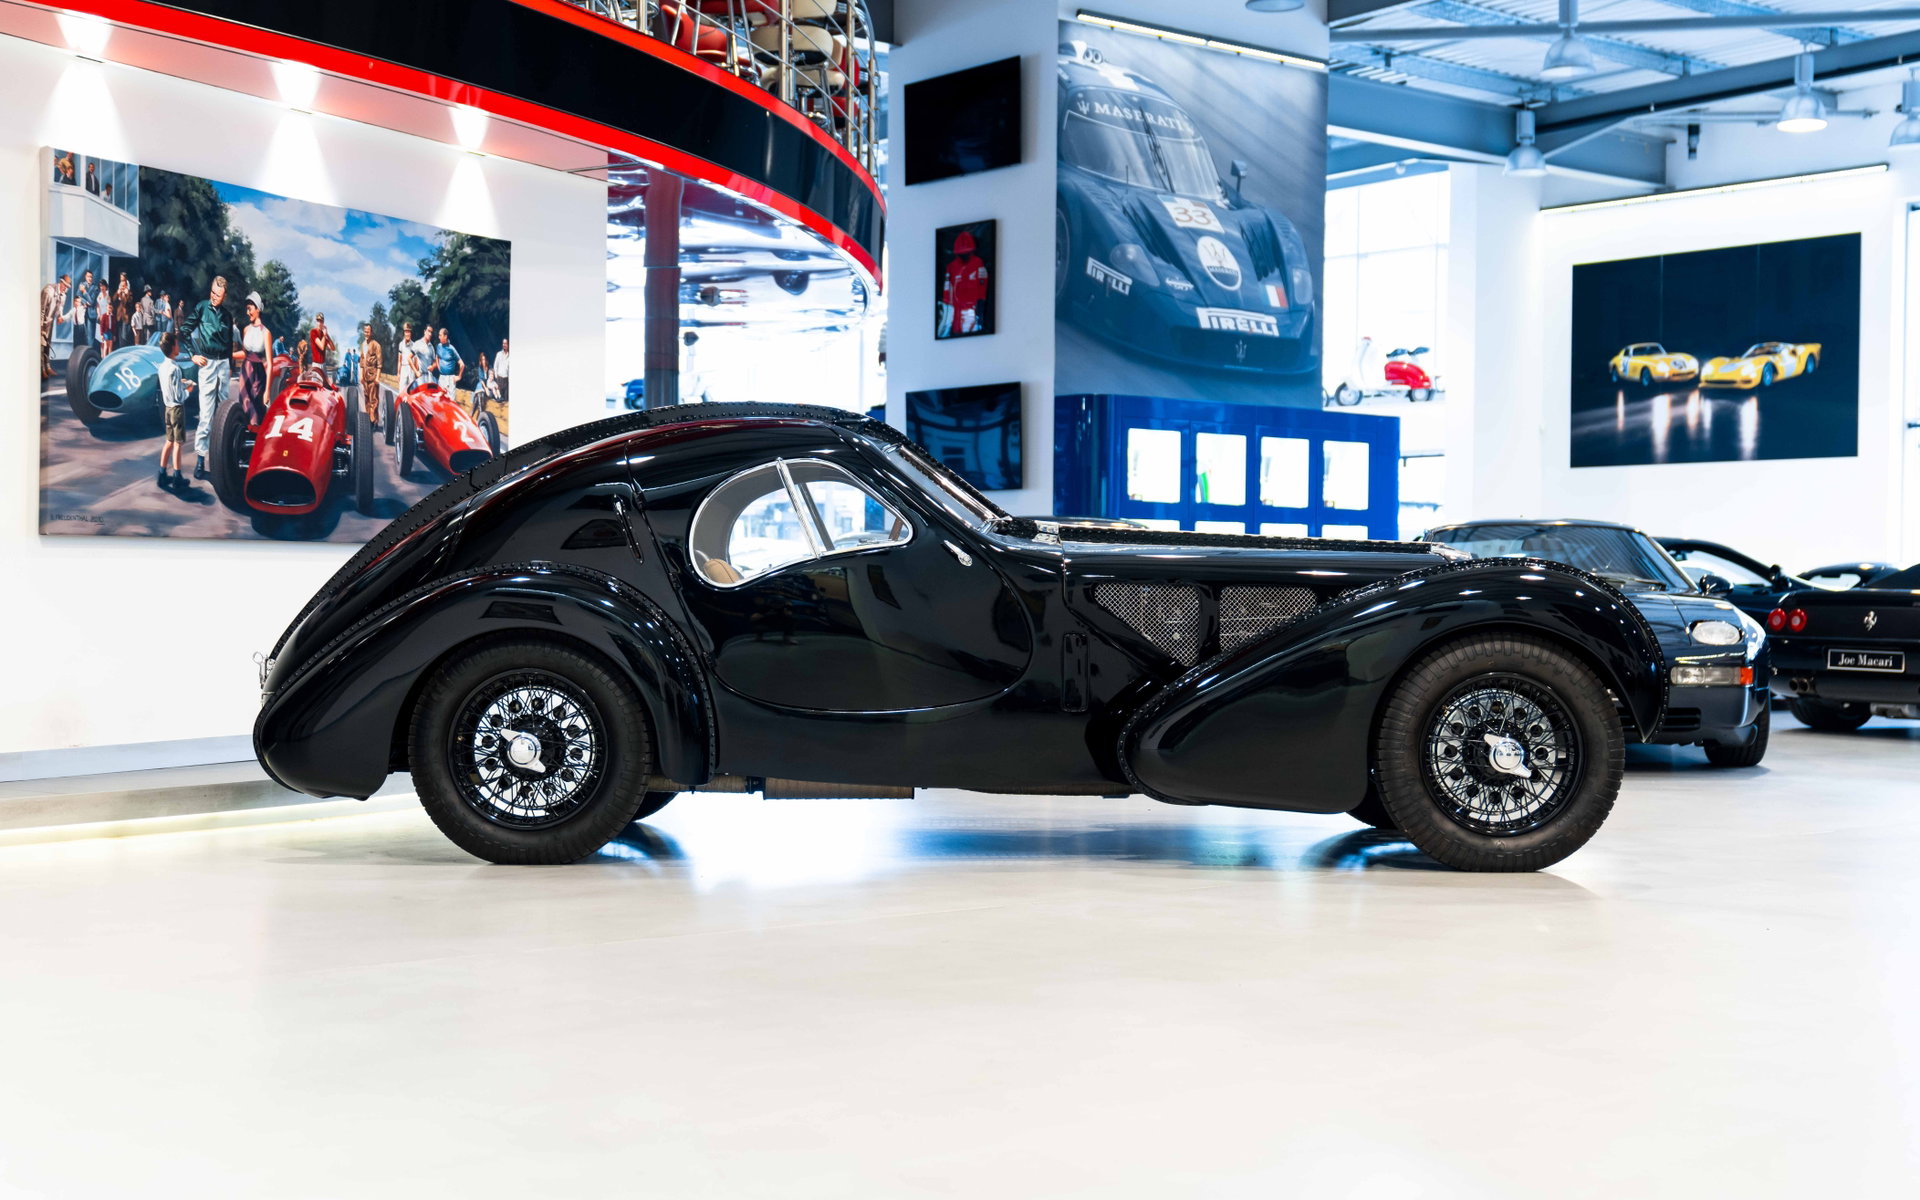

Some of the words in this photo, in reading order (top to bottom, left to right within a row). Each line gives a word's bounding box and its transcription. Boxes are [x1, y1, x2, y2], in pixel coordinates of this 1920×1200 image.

[1094, 102, 1184, 131] MASERATI
[1174, 207, 1211, 225] 33
[1196, 307, 1279, 337] PIRELLI
[115, 367, 141, 390] 18
[264, 415, 314, 442] 14
[453, 421, 475, 442] 2
[1838, 653, 1855, 666] Joe
[1857, 654, 1894, 667] Macari
